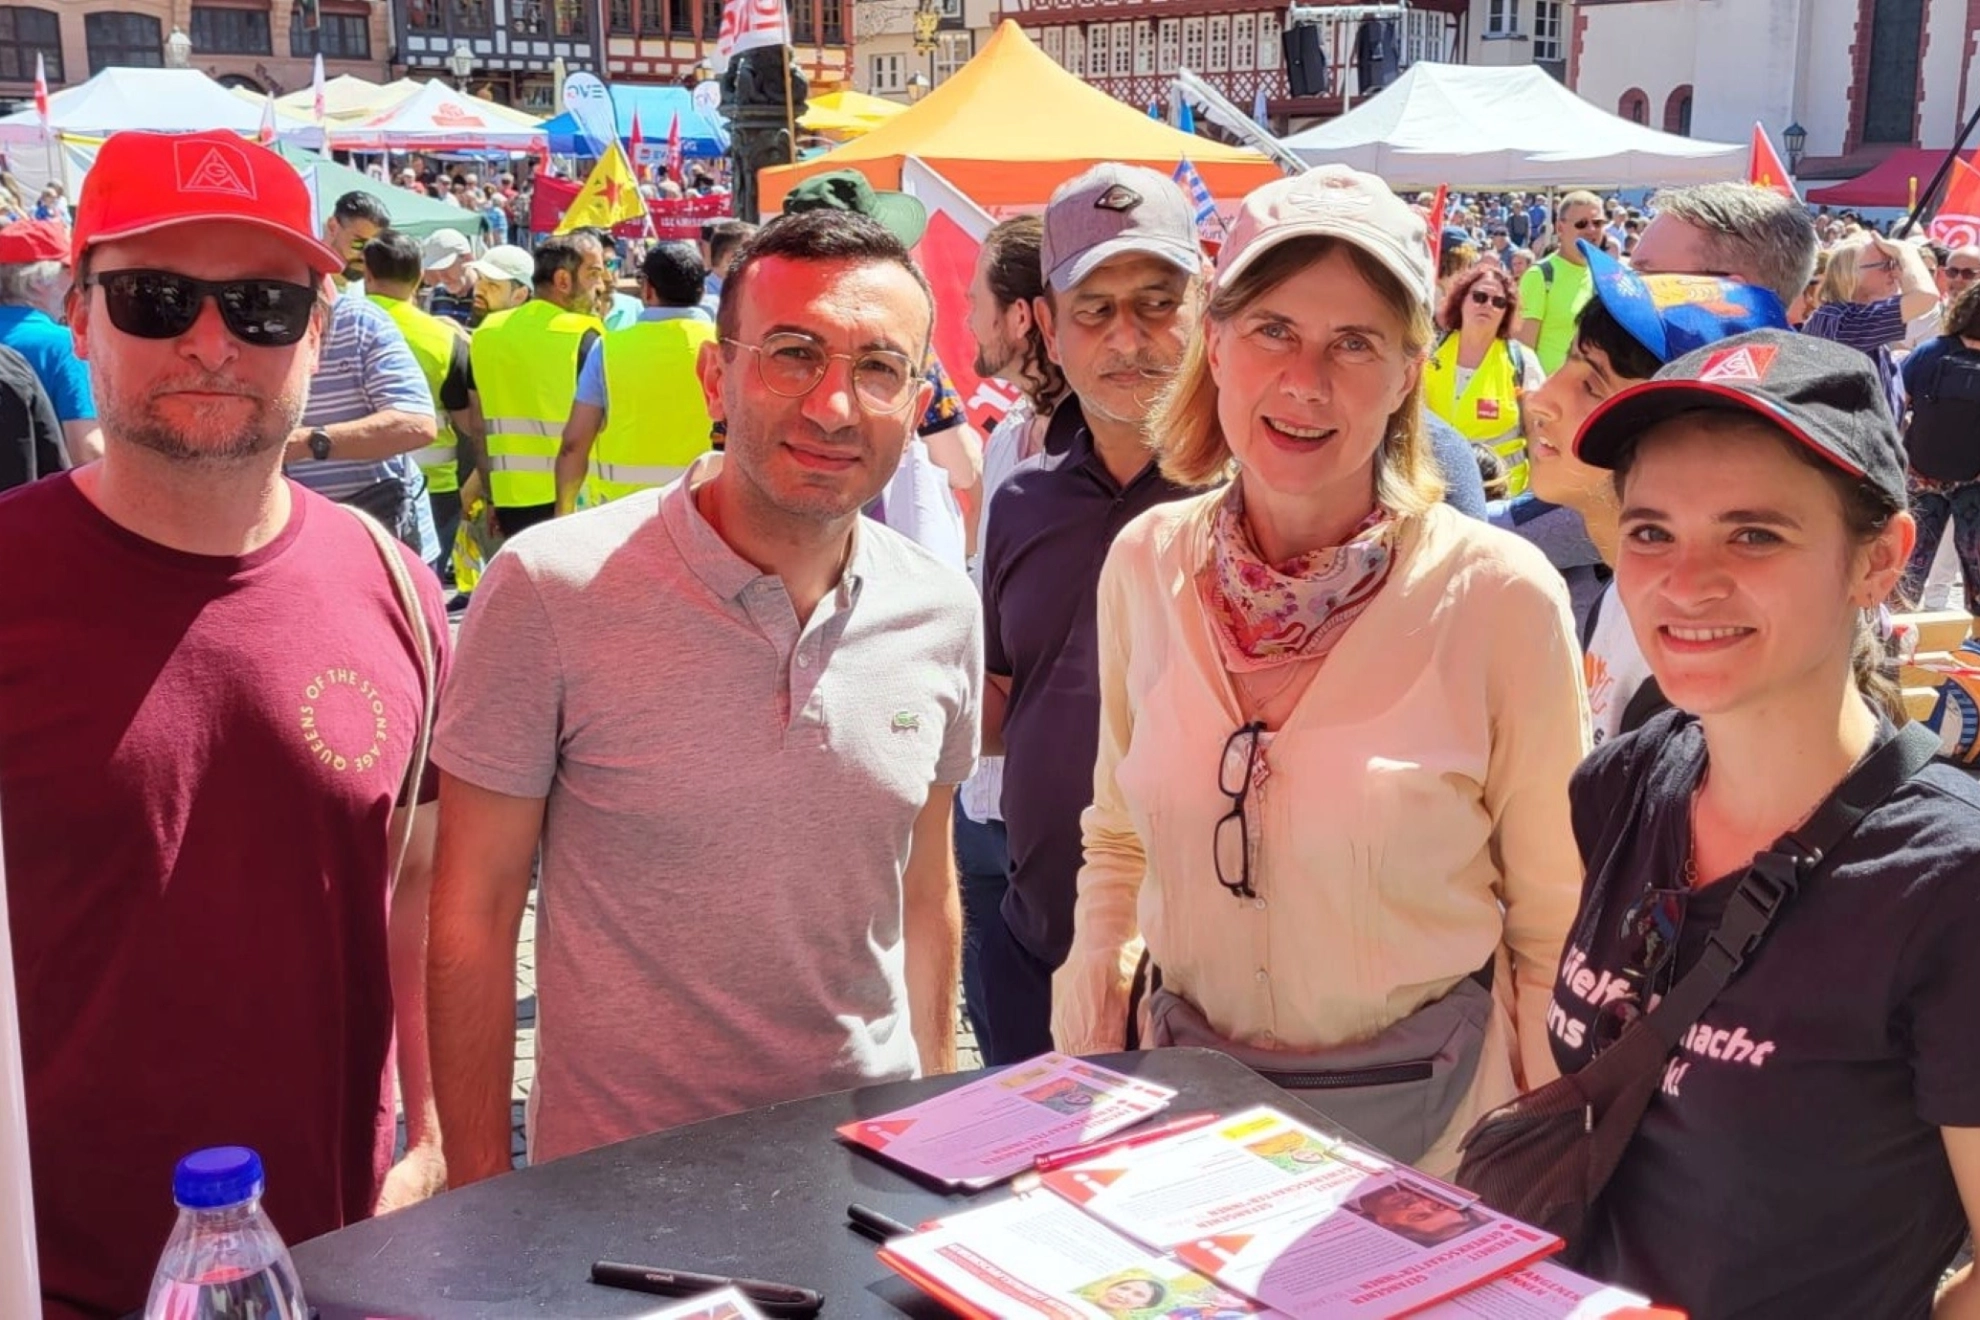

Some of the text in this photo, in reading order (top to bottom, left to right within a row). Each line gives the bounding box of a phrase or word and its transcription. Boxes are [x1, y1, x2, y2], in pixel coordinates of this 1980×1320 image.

[300, 668, 387, 772] QUEENS OF THE STONE AGE
